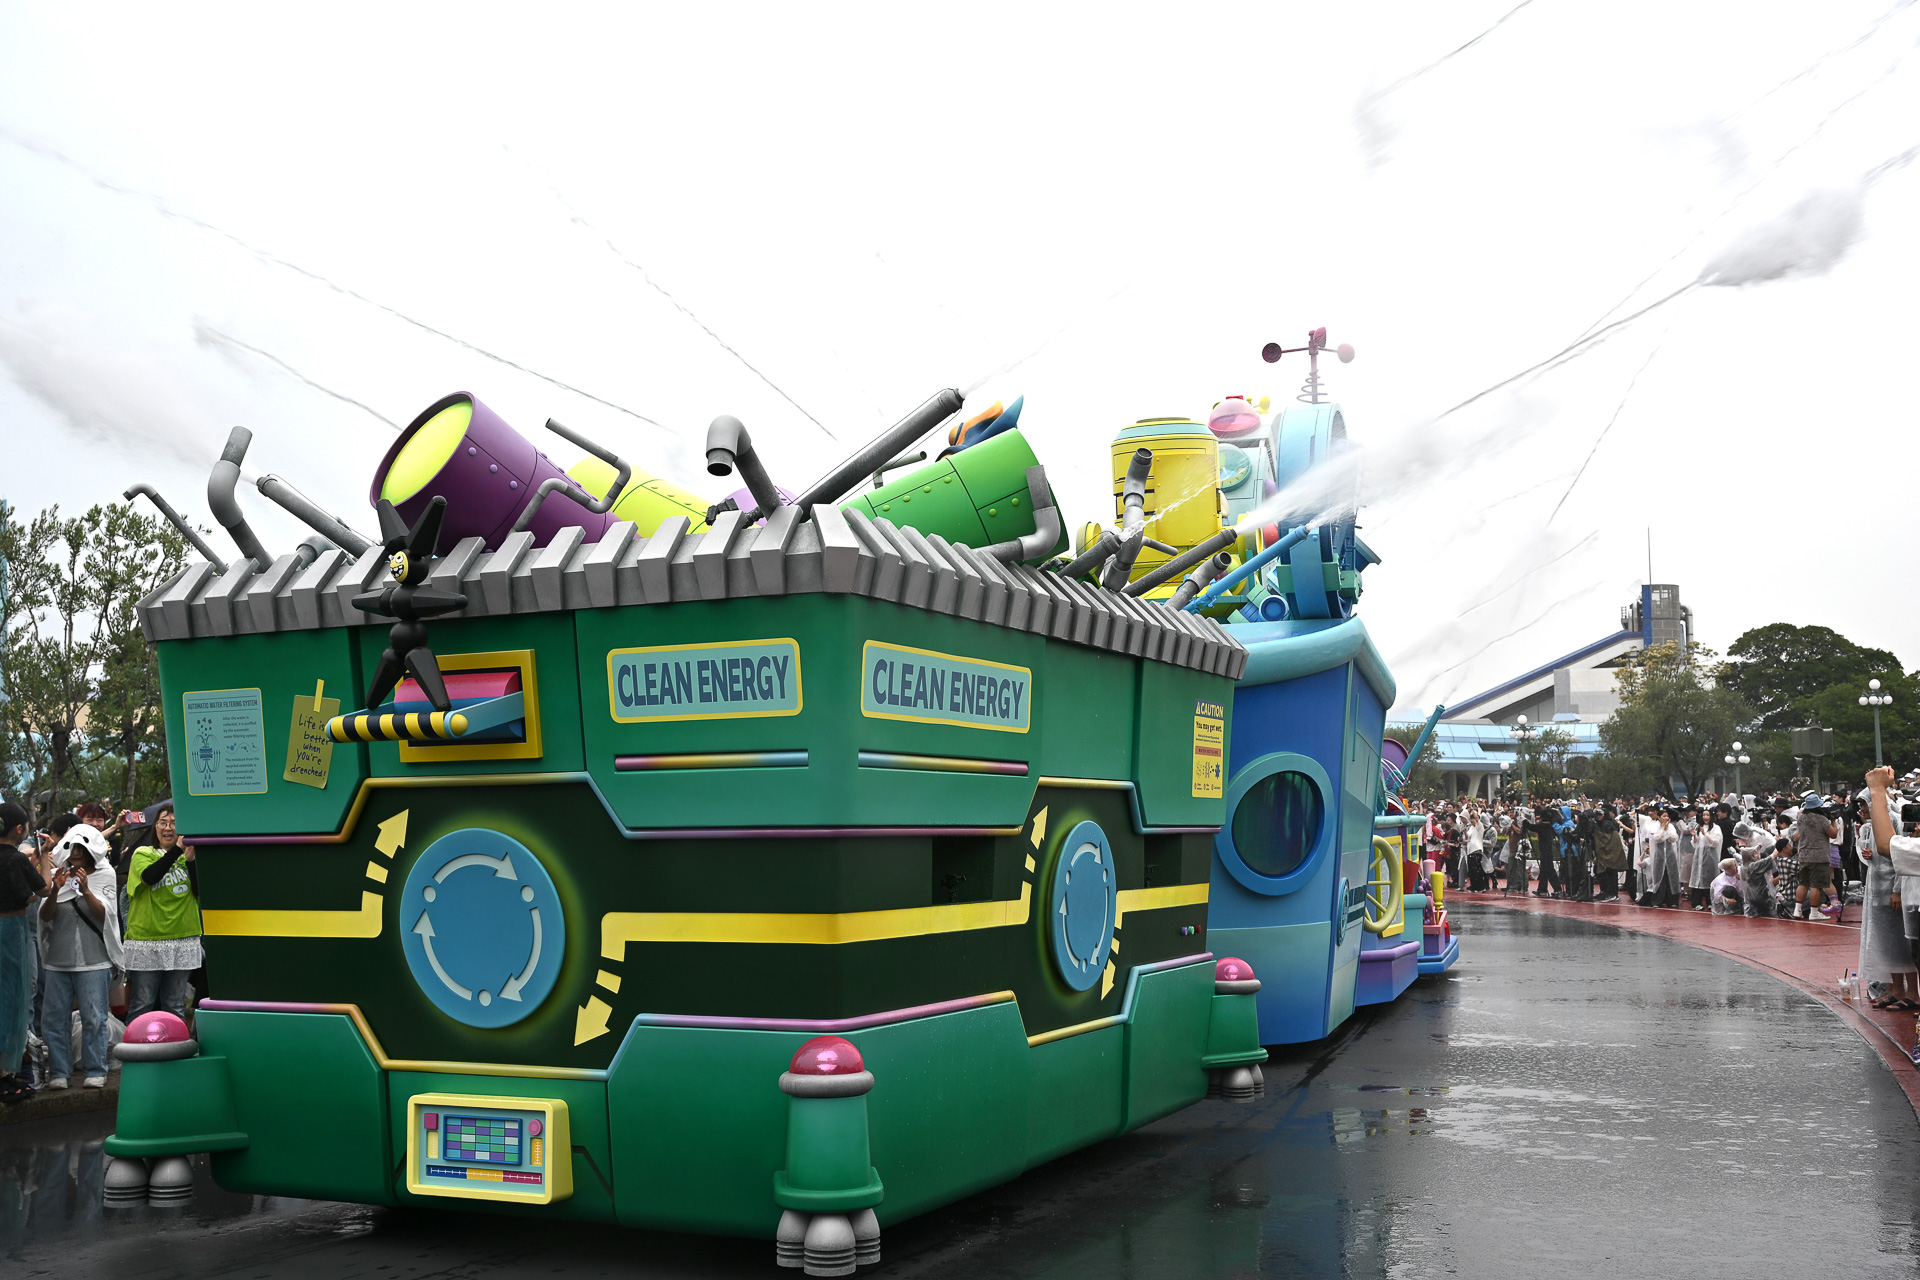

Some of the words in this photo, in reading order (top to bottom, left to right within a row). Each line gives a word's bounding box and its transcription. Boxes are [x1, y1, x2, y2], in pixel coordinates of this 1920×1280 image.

[618, 661, 693, 707] CLEAN
[697, 655, 789, 703] ENERGY
[873, 658, 945, 710] CLEAN
[950, 671, 1024, 720] ENERGY
[1201, 702, 1223, 718] CAUTION
[299, 713, 316, 730] Life
[304, 731, 330, 746] better
[303, 743, 320, 753] when
[290, 764, 326, 780] drenched!
